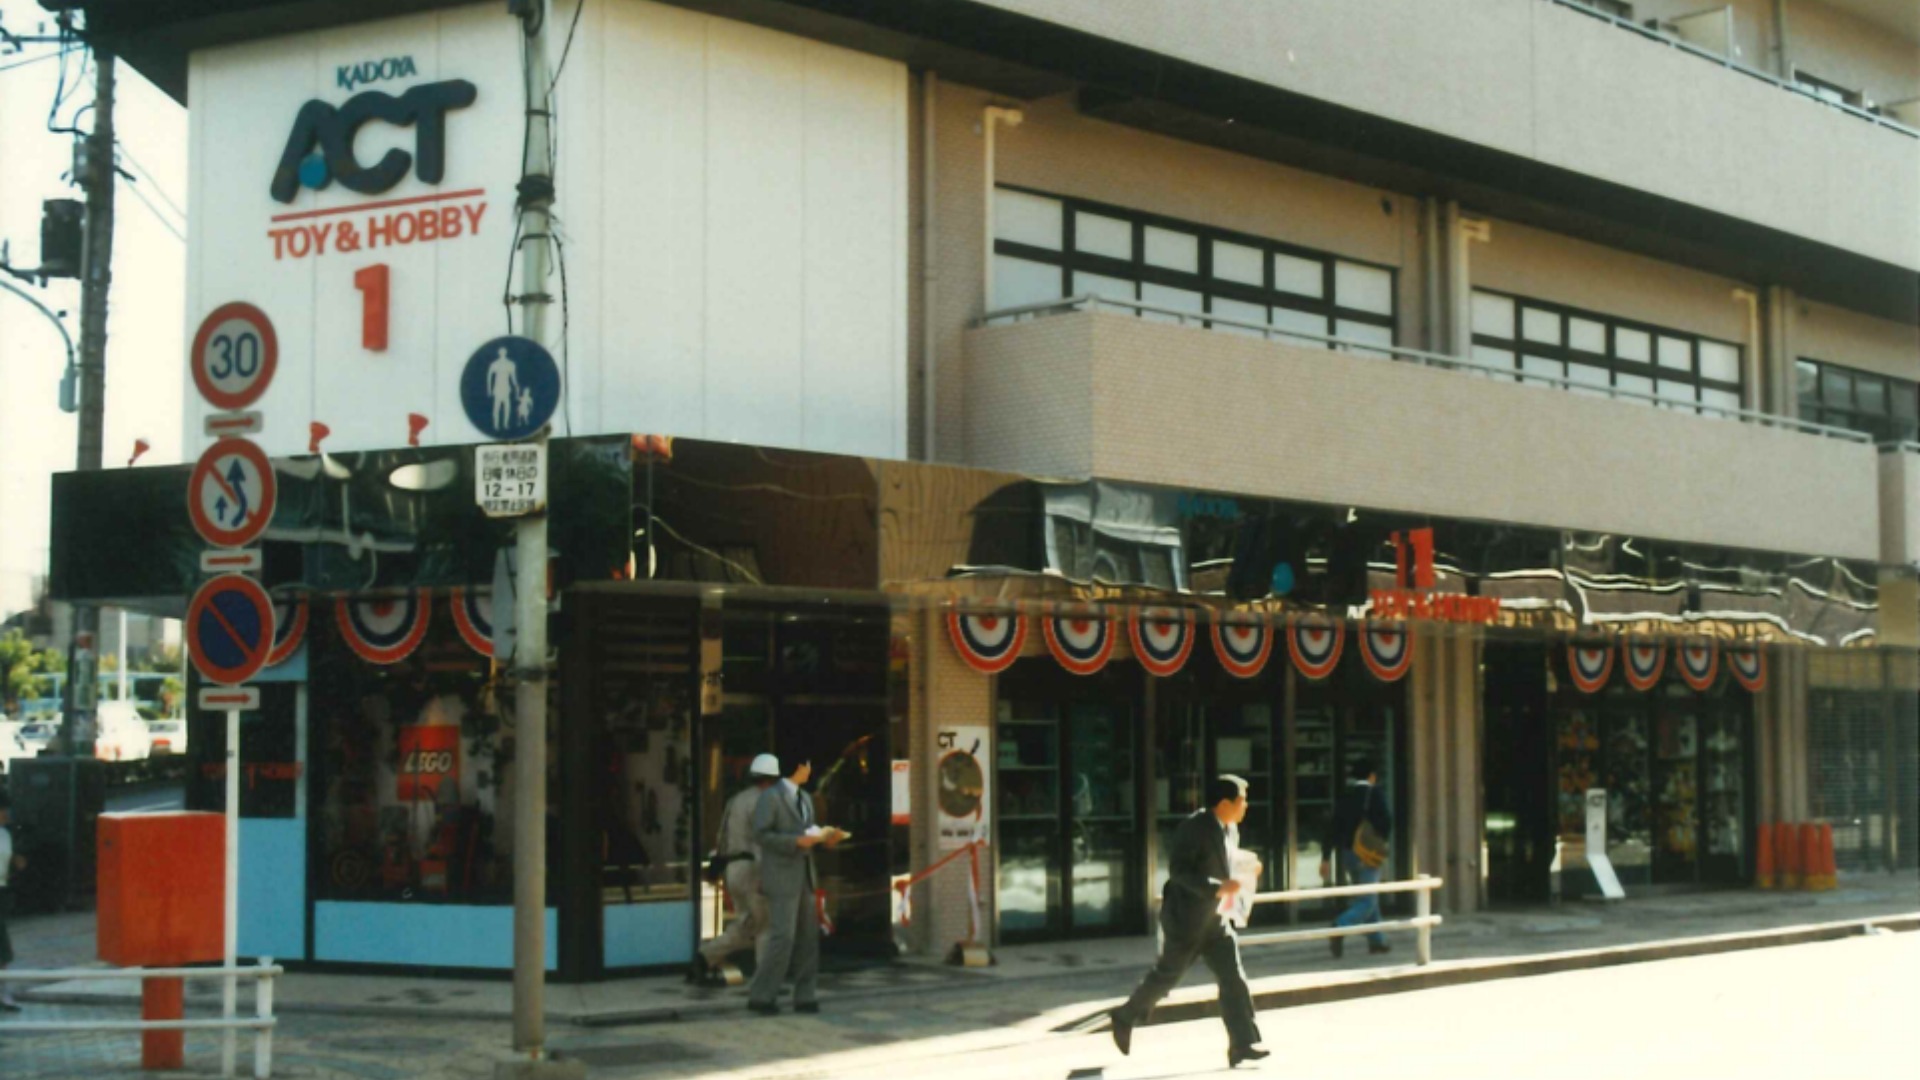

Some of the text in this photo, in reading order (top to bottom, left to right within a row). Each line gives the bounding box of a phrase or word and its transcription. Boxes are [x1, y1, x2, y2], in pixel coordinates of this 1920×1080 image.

[337, 56, 417, 91] KADOYA
[269, 78, 478, 205] ACT
[267, 202, 488, 260] TOY & HOBBY
[354, 263, 390, 352] 1
[211, 331, 258, 380] 30
[404, 750, 452, 774] LEGO
